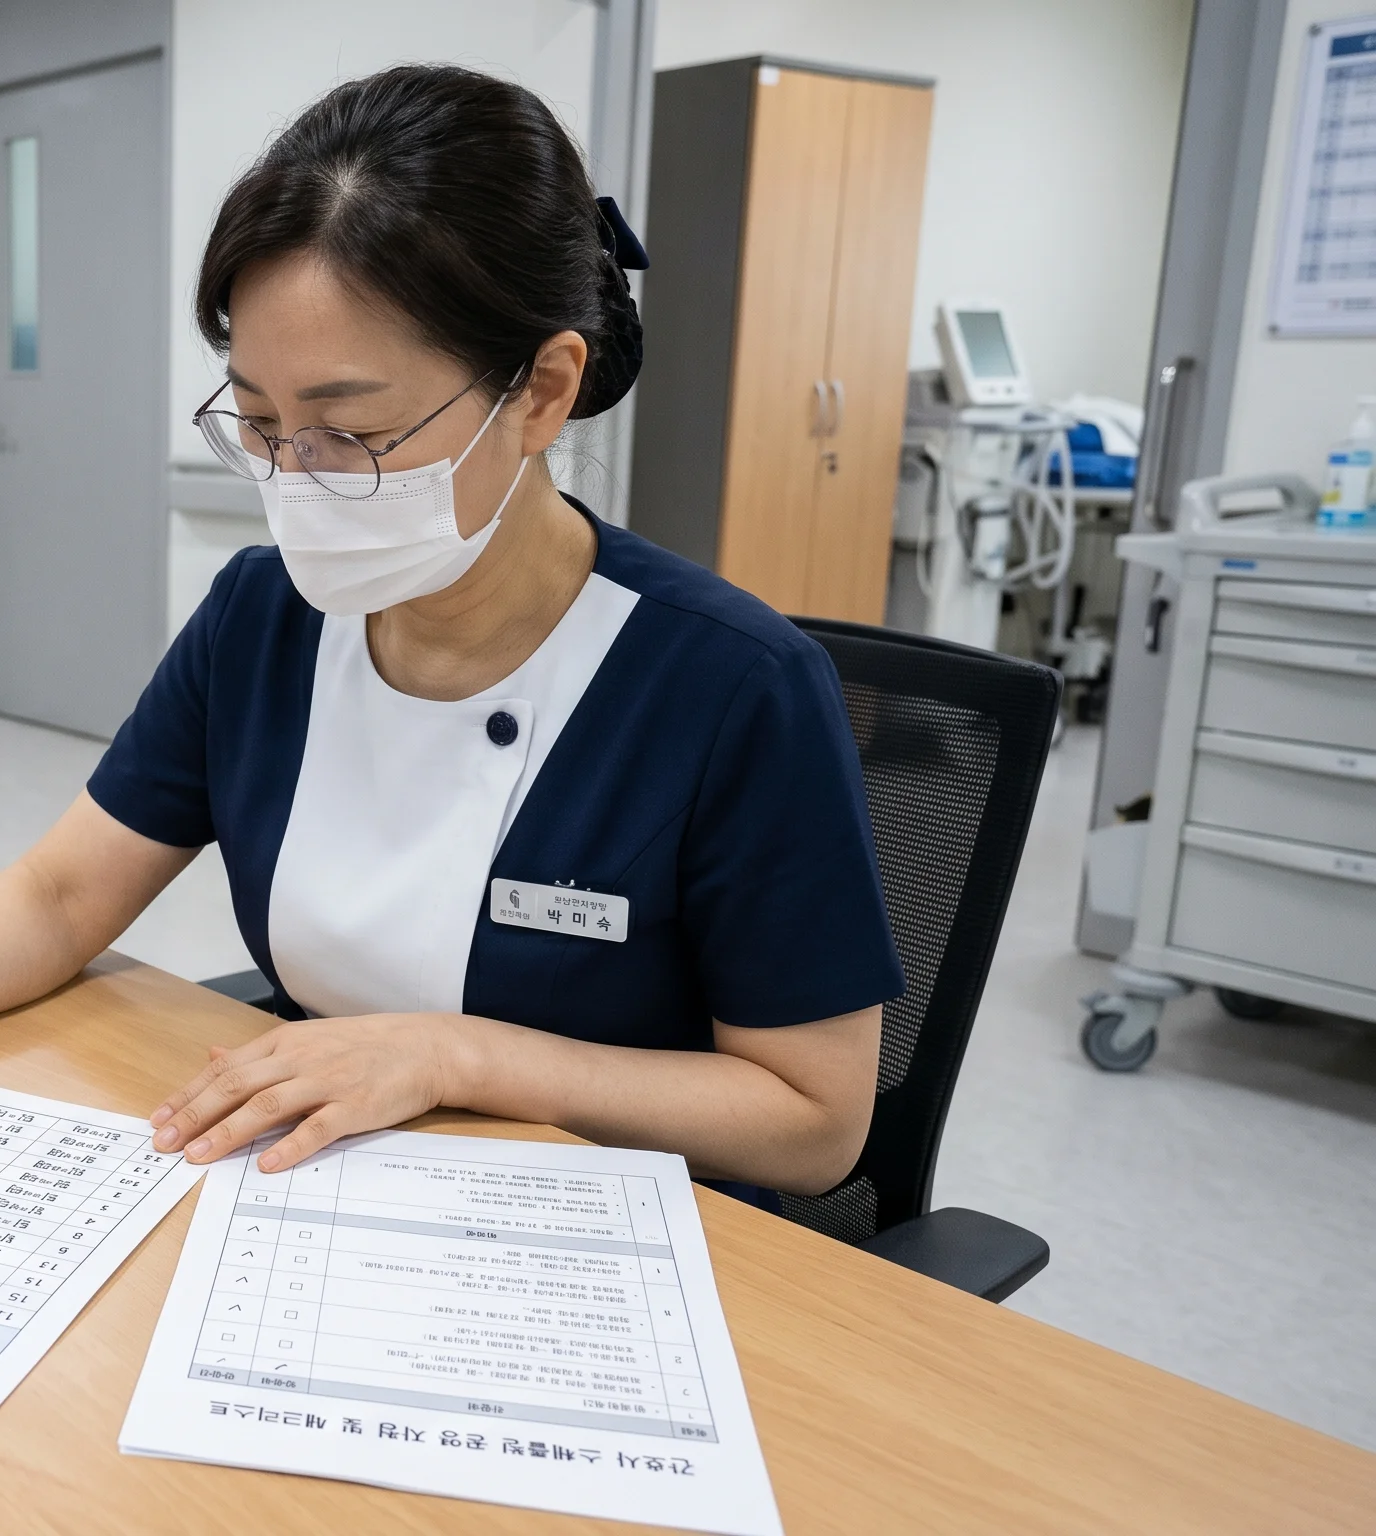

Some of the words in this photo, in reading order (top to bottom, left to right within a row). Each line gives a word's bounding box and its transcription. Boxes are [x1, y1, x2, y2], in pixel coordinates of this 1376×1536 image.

[548, 909, 562, 924] 박
[573, 912, 586, 927] 미
[597, 916, 611, 931] 숙
[39, 1262, 57, 1270] 13
[9, 1293, 27, 1302] 15
[618, 1452, 690, 1474] 간호사
